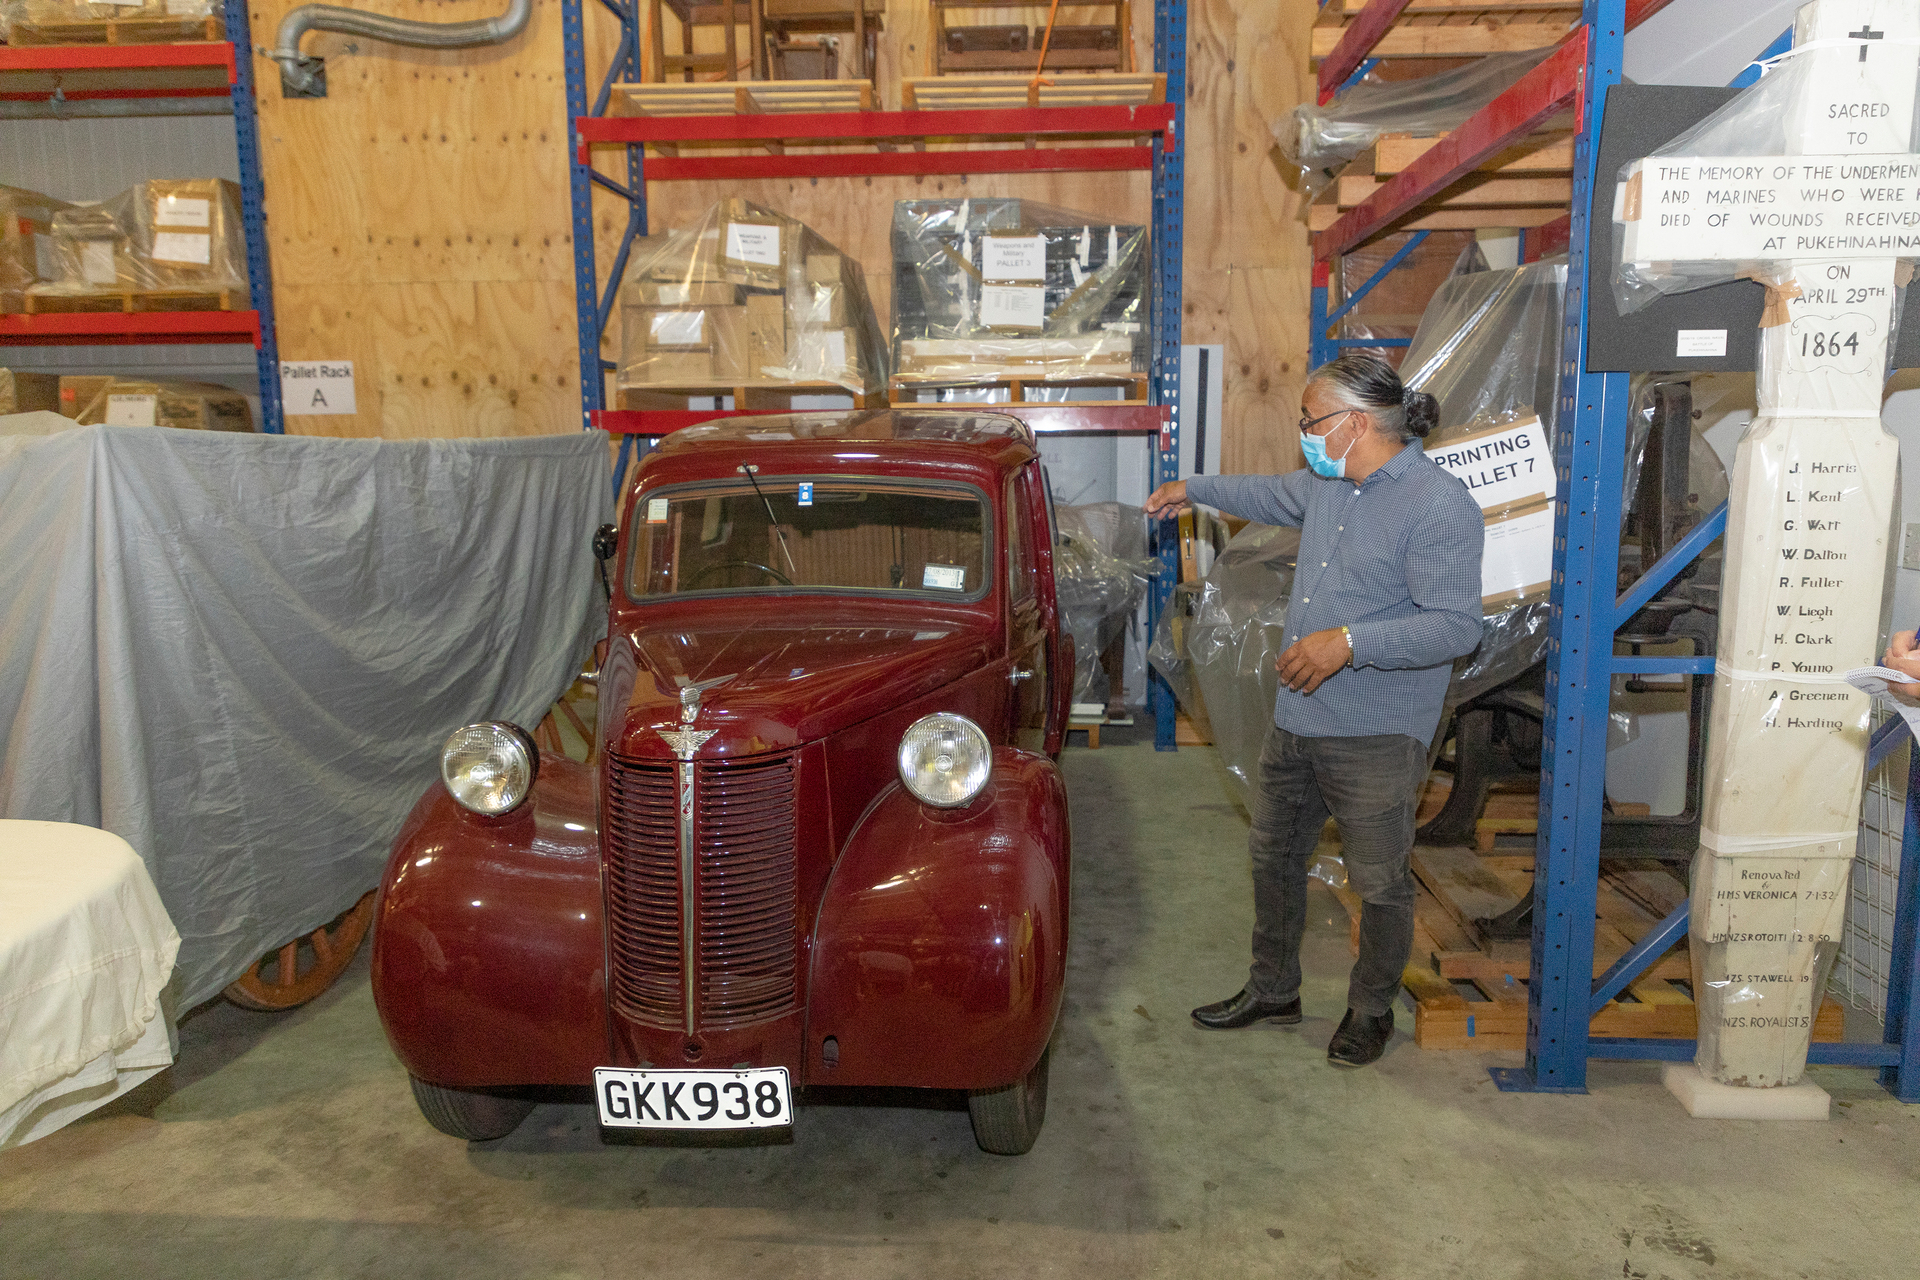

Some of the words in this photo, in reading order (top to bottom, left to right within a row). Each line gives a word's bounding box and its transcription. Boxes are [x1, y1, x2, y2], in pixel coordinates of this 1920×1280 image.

[1827, 103, 1891, 120] SACRED
[1846, 131, 1869, 146] TO
[1659, 166, 1691, 181] THE
[1698, 166, 1764, 181] MEMORY
[1773, 166, 1796, 180] OF
[1803, 165, 1834, 180] THE
[1840, 164, 1919, 180] UNDERMEN
[1660, 190, 1691, 204] AND
[1706, 189, 1777, 204] MARINES
[1800, 188, 1845, 203] WHO
[1859, 187, 1906, 202] WERE
[1660, 213, 1691, 227] DIED
[1707, 213, 1731, 228] OF
[1749, 212, 1824, 227] WOUNDS
[1845, 211, 1920, 227] RECEIVED
[1762, 236, 1787, 251] AT
[1796, 235, 1920, 250] PUKEHINAHINA
[996, 259, 1024, 267] PALLET
[1826, 265, 1851, 280] ON
[1793, 288, 1839, 305] APRIL
[1801, 331, 1860, 358] 1864
[282, 366, 318, 379] Pallet
[320, 365, 352, 378] Rack
[311, 388, 328, 407] A
[1434, 434, 1532, 469] PRINTING
[1458, 461, 1519, 490] LLET
[1524, 458, 1536, 473] 7
[1789, 462, 1802, 474] J.
[1811, 462, 1857, 474] Harris
[802, 491, 809, 500] 8
[1786, 490, 1801, 503] L.
[1808, 490, 1844, 502] Kent
[1783, 519, 1798, 531] G.
[1782, 548, 1799, 560] W.
[1803, 548, 1847, 560] Dalton
[1779, 577, 1794, 588] R.
[1800, 577, 1844, 588] Fuller
[1776, 605, 1791, 616] W.
[1774, 633, 1788, 645] H.
[1795, 633, 1833, 645] Clark
[1771, 661, 1785, 673] P.
[1791, 661, 1834, 674] Young
[1787, 717, 1843, 734] Harding
[1741, 869, 1801, 880] Renovated
[1716, 890, 1741, 900] HMS
[1742, 890, 1798, 900] VERONICA
[1747, 974, 1794, 983] STAWELL
[1749, 1016, 1799, 1028] ROYALIST
[604, 1080, 782, 1121] GKK938
